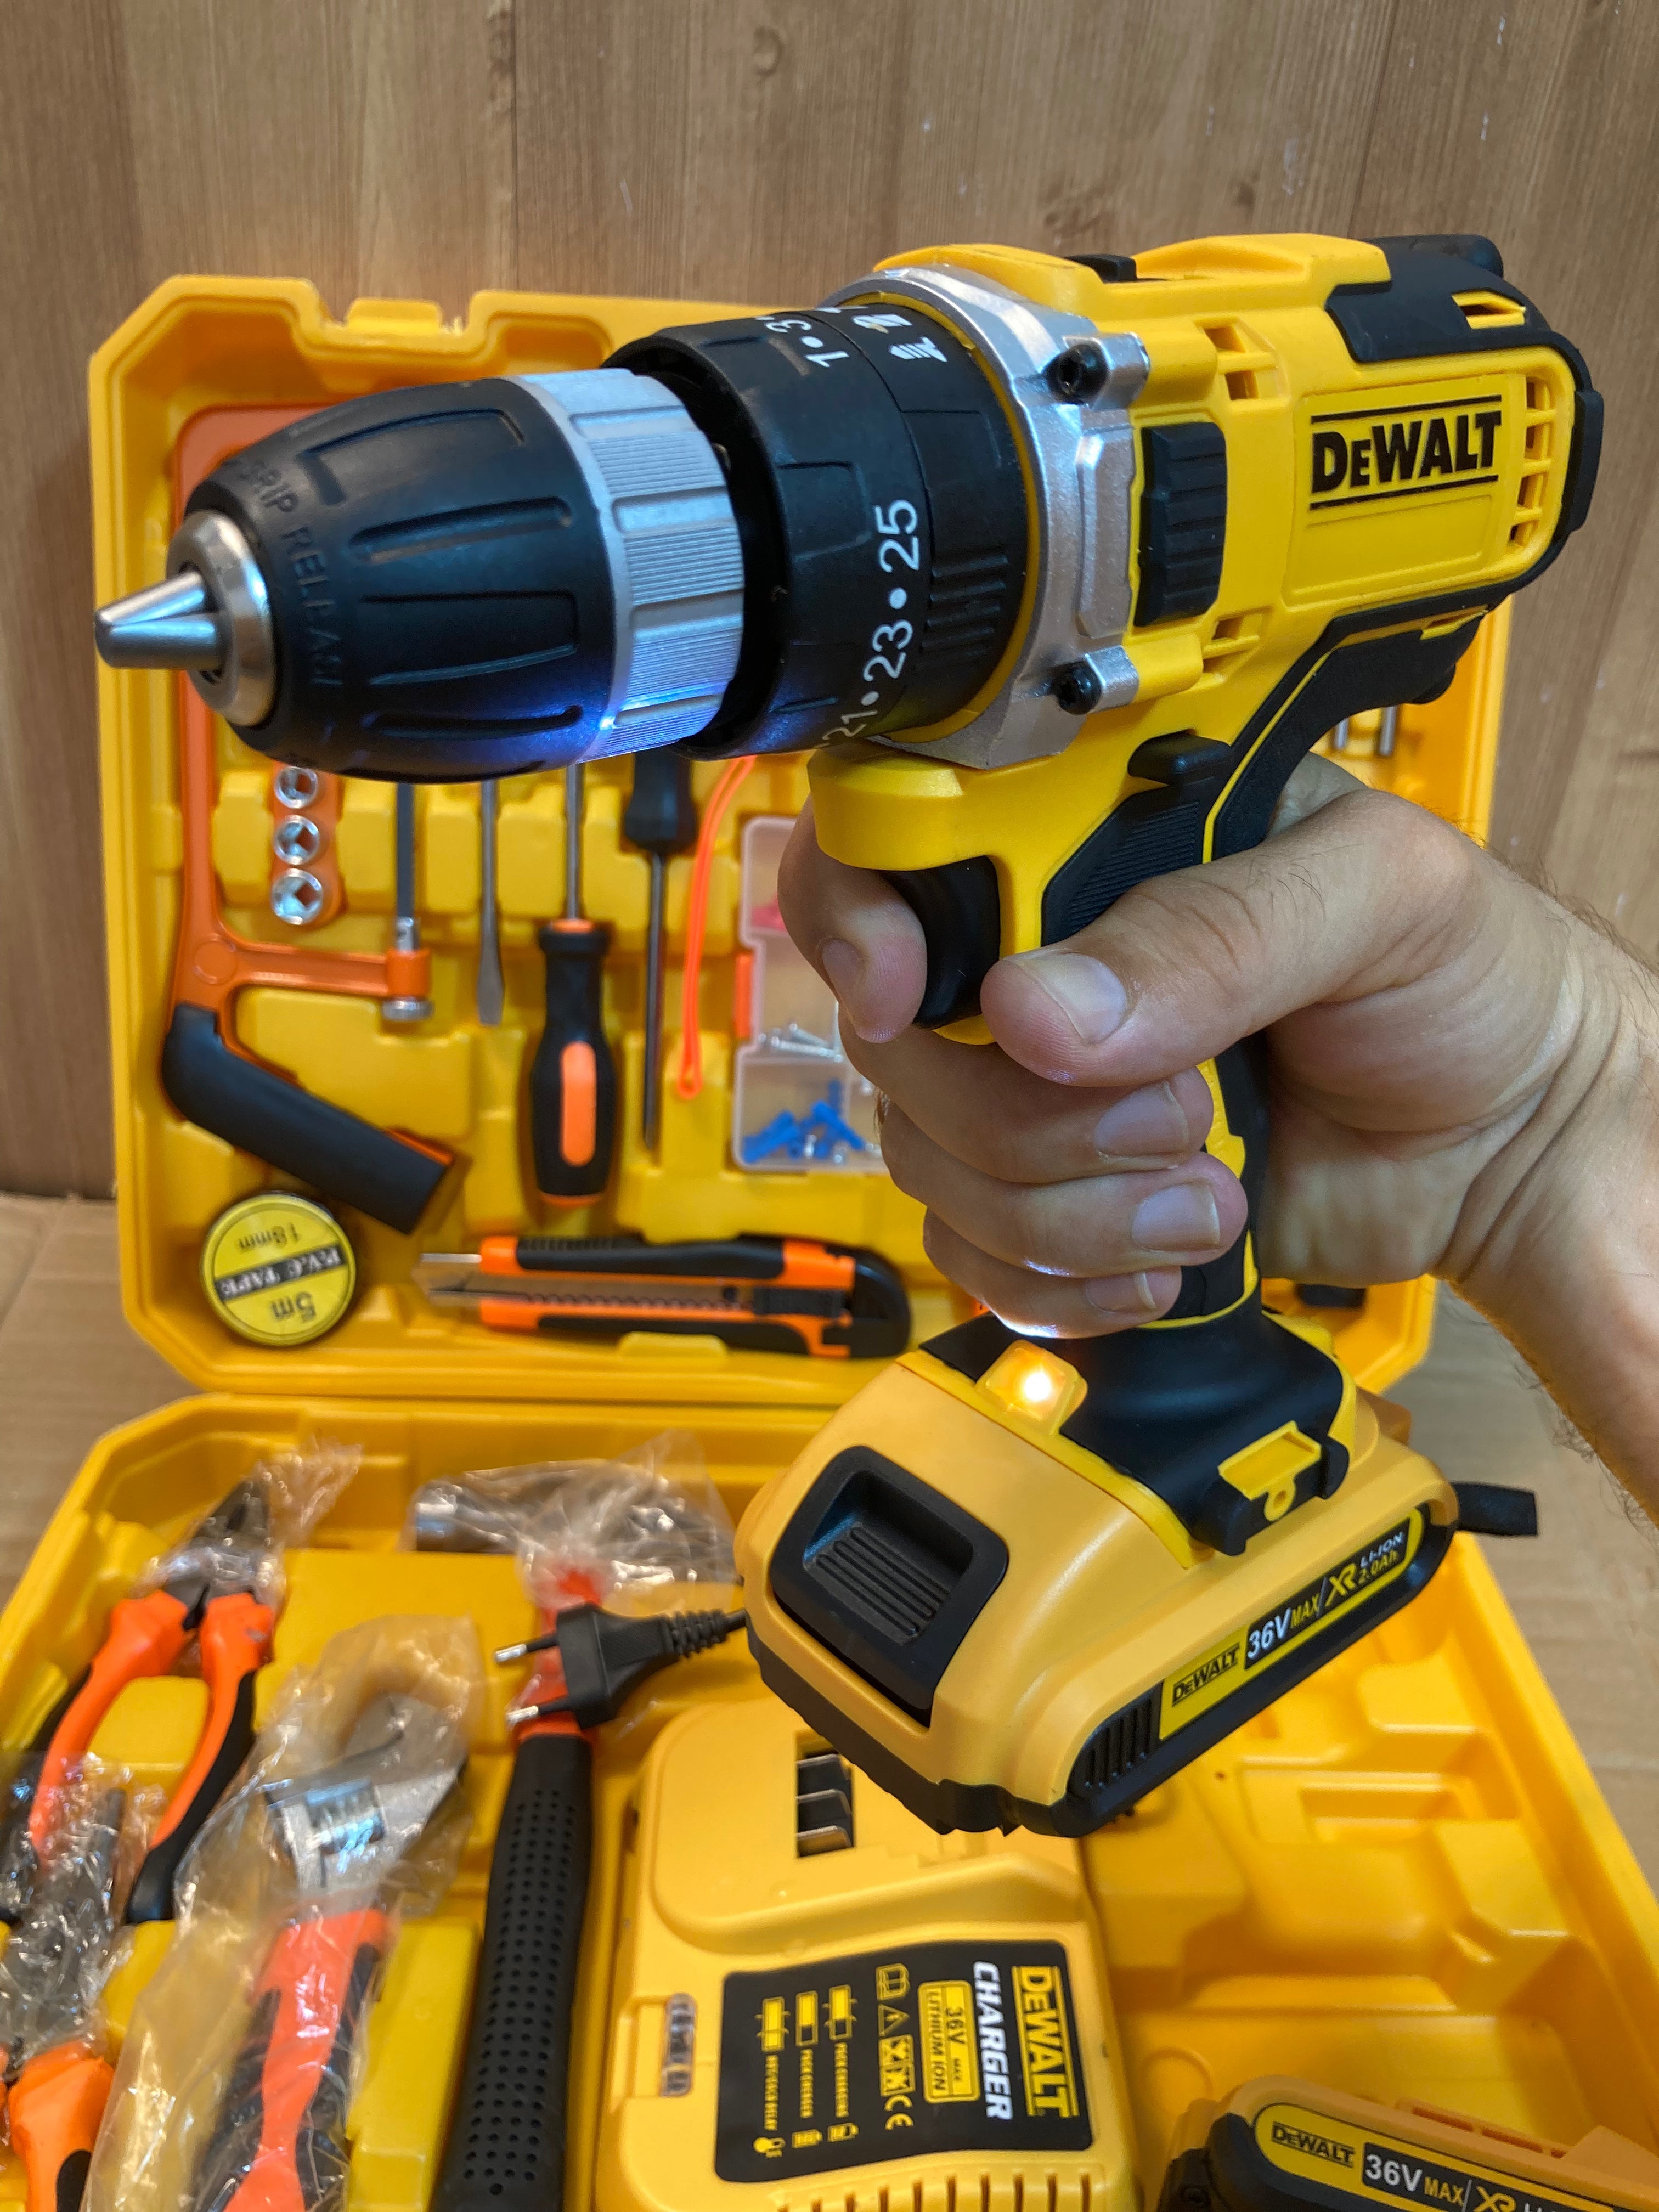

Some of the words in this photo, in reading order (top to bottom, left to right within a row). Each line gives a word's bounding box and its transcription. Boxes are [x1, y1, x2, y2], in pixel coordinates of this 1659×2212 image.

[766, 319, 812, 333] 3
[874, 499, 919, 573] 25
[863, 619, 913, 682] 23
[822, 710, 878, 741] 21
[271, 1291, 317, 1323] 5m
[1247, 1607, 1292, 1660] 36V
[1290, 1593, 1320, 1629] MAX
[1325, 1562, 1356, 1607] XR
[926, 1990, 944, 2055] LITHIUM
[946, 2007, 966, 2044] 36V
[973, 1961, 1014, 2120] CHARGER
[934, 2061, 947, 2091] ION
[1365, 2153, 1424, 2193] 36V
[1424, 2176, 1465, 2206] MAX
